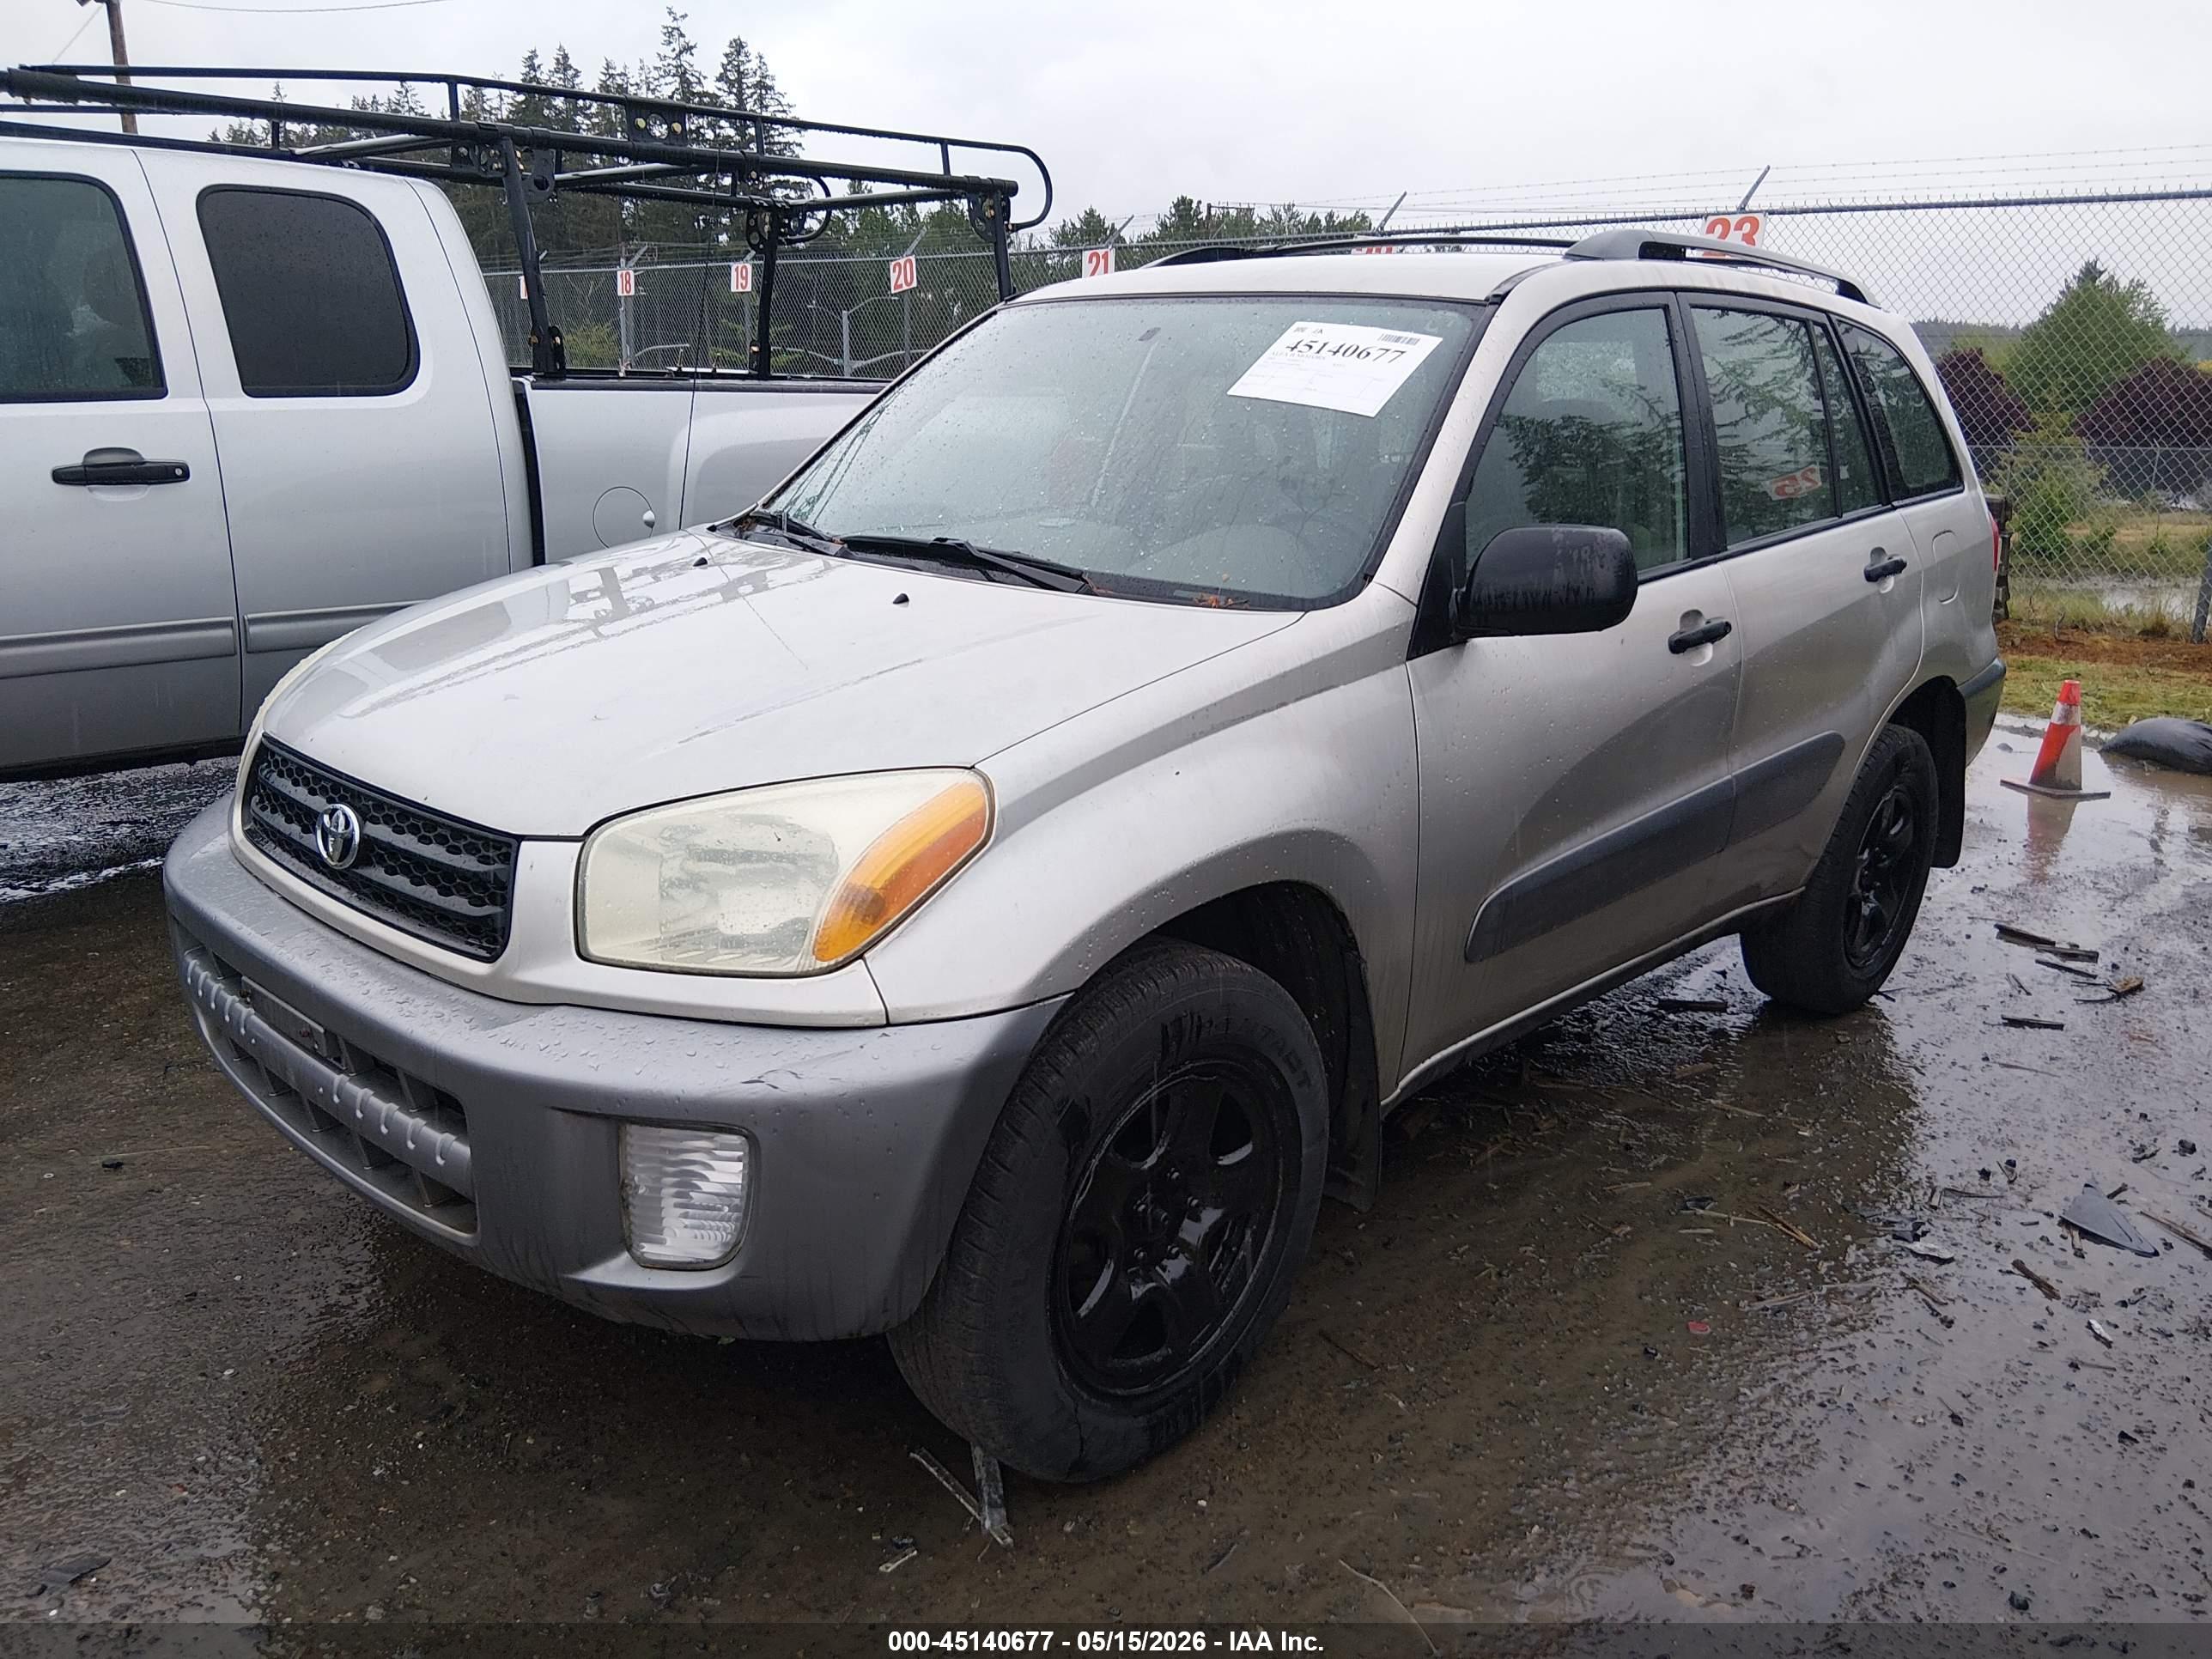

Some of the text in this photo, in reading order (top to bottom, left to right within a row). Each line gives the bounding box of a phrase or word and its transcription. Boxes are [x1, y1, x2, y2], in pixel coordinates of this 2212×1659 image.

[892, 258, 915, 290] 20
[1087, 251, 1110, 277] 21
[619, 271, 632, 294] 18
[735, 265, 749, 290] 19
[1285, 339, 1407, 363] 45140677
